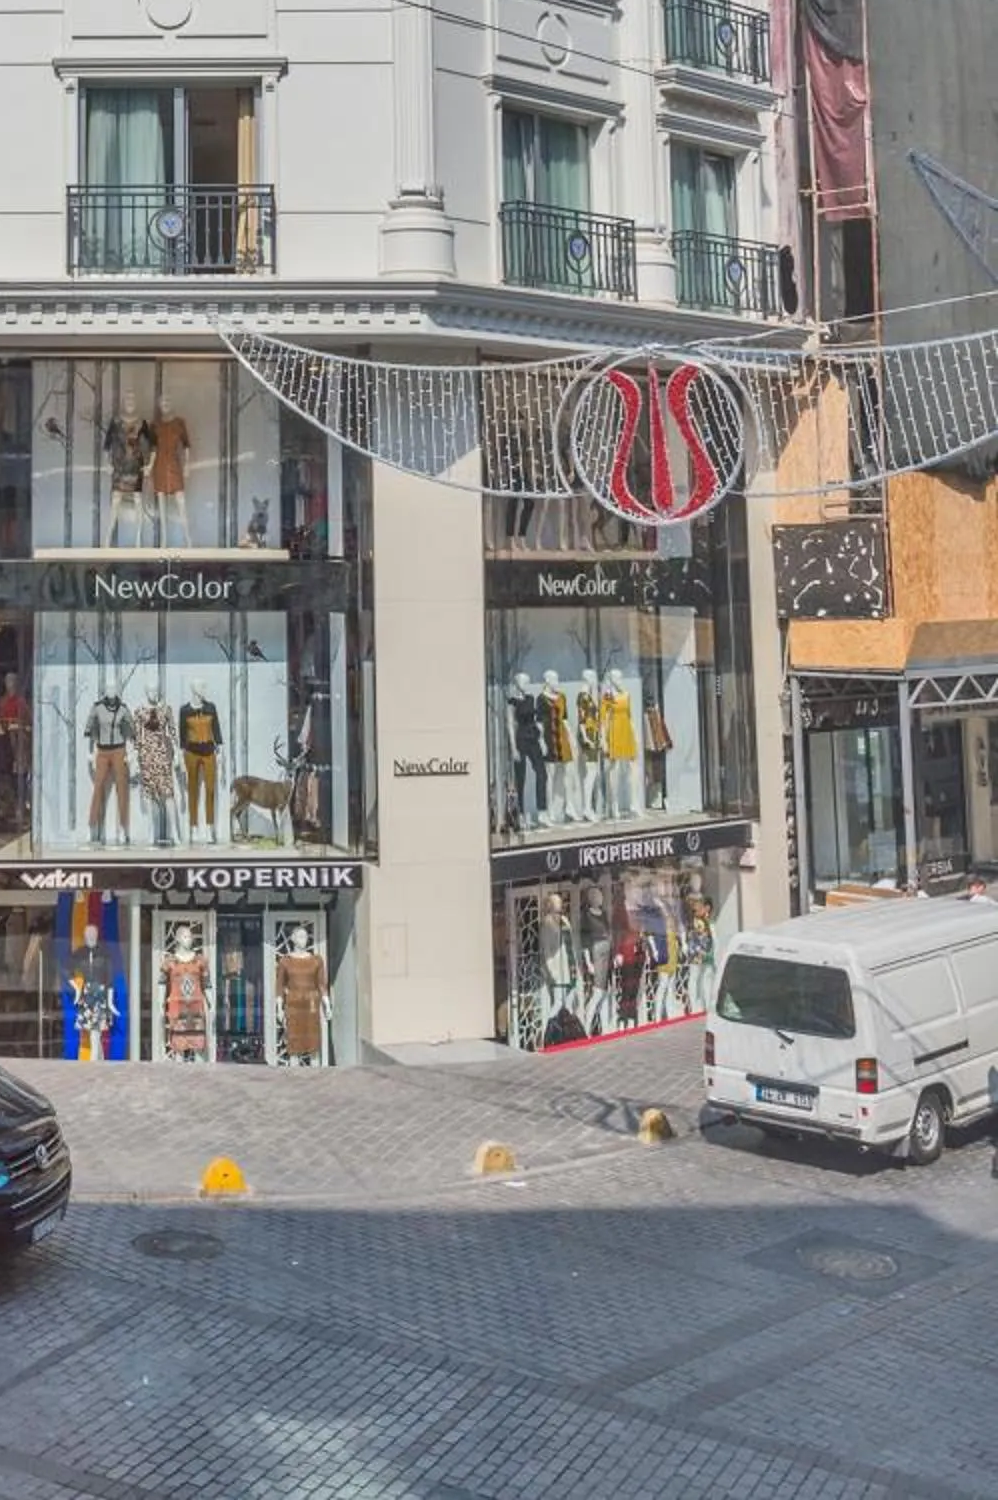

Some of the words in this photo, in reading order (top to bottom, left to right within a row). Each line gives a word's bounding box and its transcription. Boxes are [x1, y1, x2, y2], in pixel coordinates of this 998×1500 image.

[95, 572, 233, 600] NewColor
[538, 568, 618, 596] NewColor
[393, 757, 470, 776] NewColor
